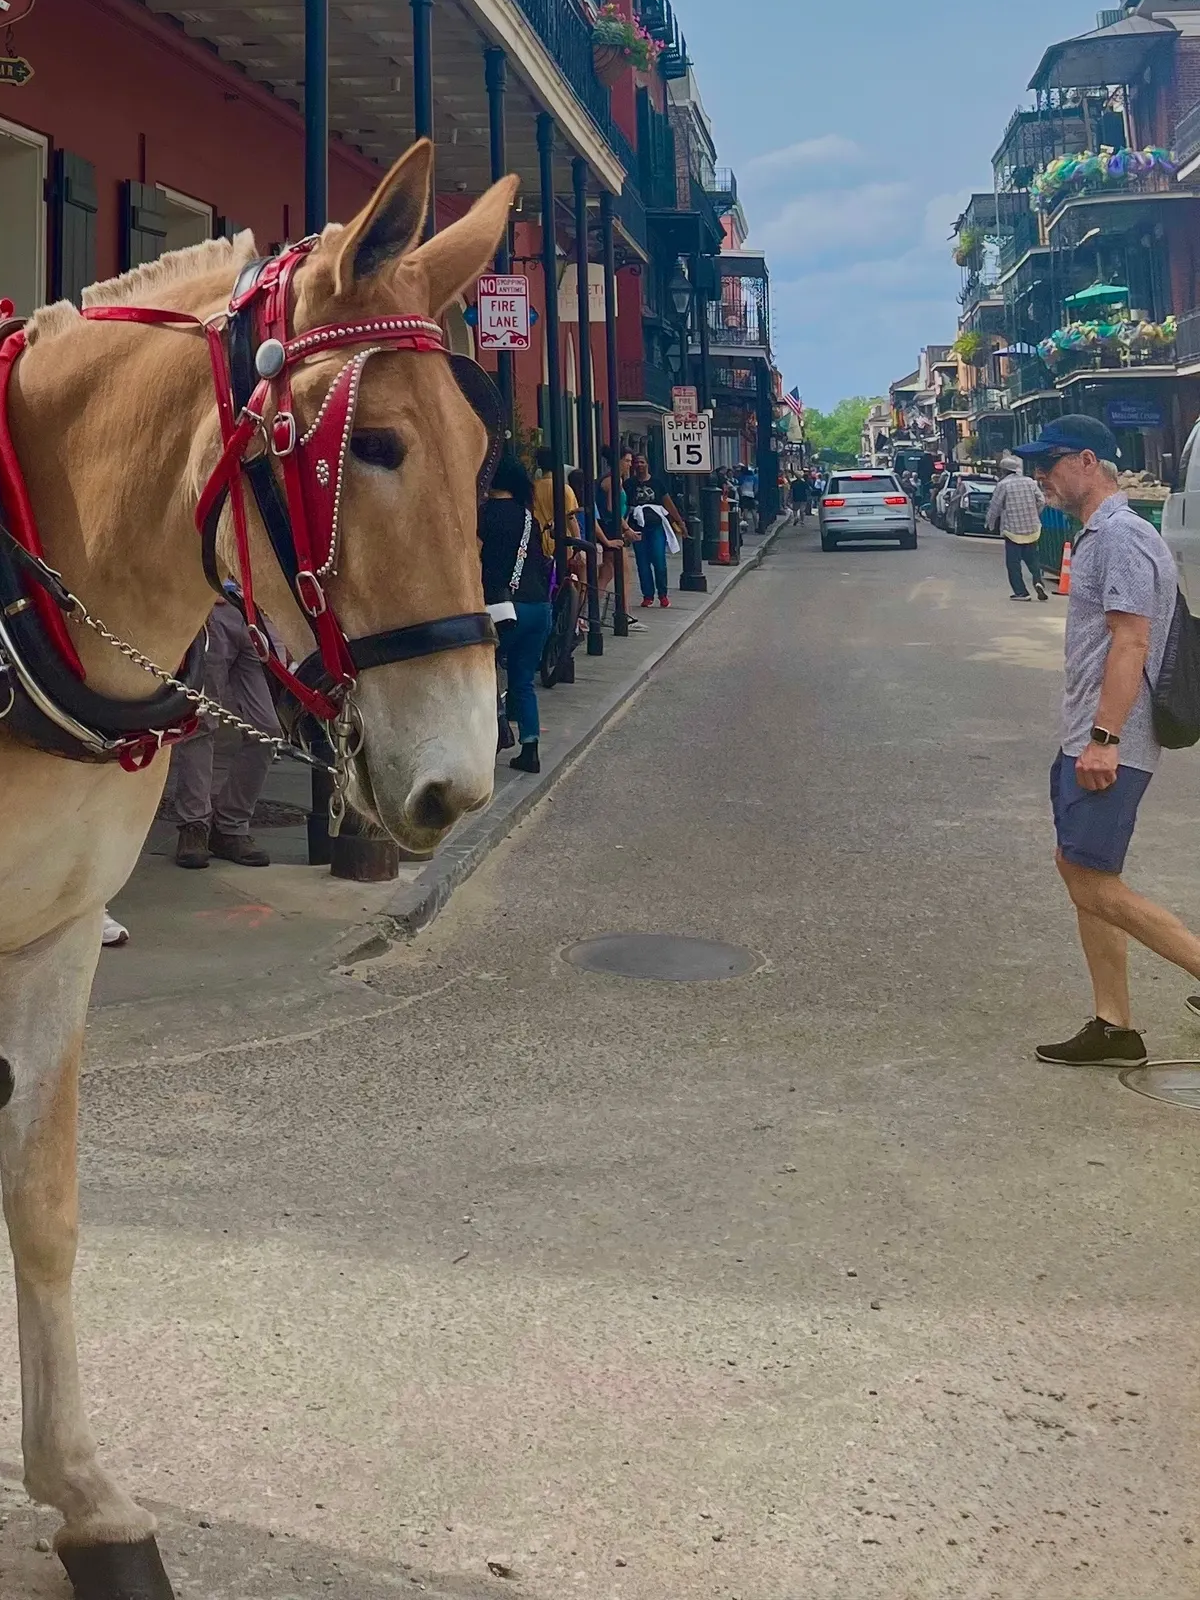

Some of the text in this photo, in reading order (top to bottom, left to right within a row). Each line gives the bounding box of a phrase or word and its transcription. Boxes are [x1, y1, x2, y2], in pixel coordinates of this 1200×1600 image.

[480, 279, 496, 294] NO
[496, 278, 525, 286] STOPPING
[499, 286, 524, 294] ANYTIME
[491, 300, 516, 312] FIRE
[489, 316, 519, 328] LANE
[667, 420, 706, 430] SPEED
[672, 432, 702, 442] LIMIT
[673, 444, 703, 465] 15
